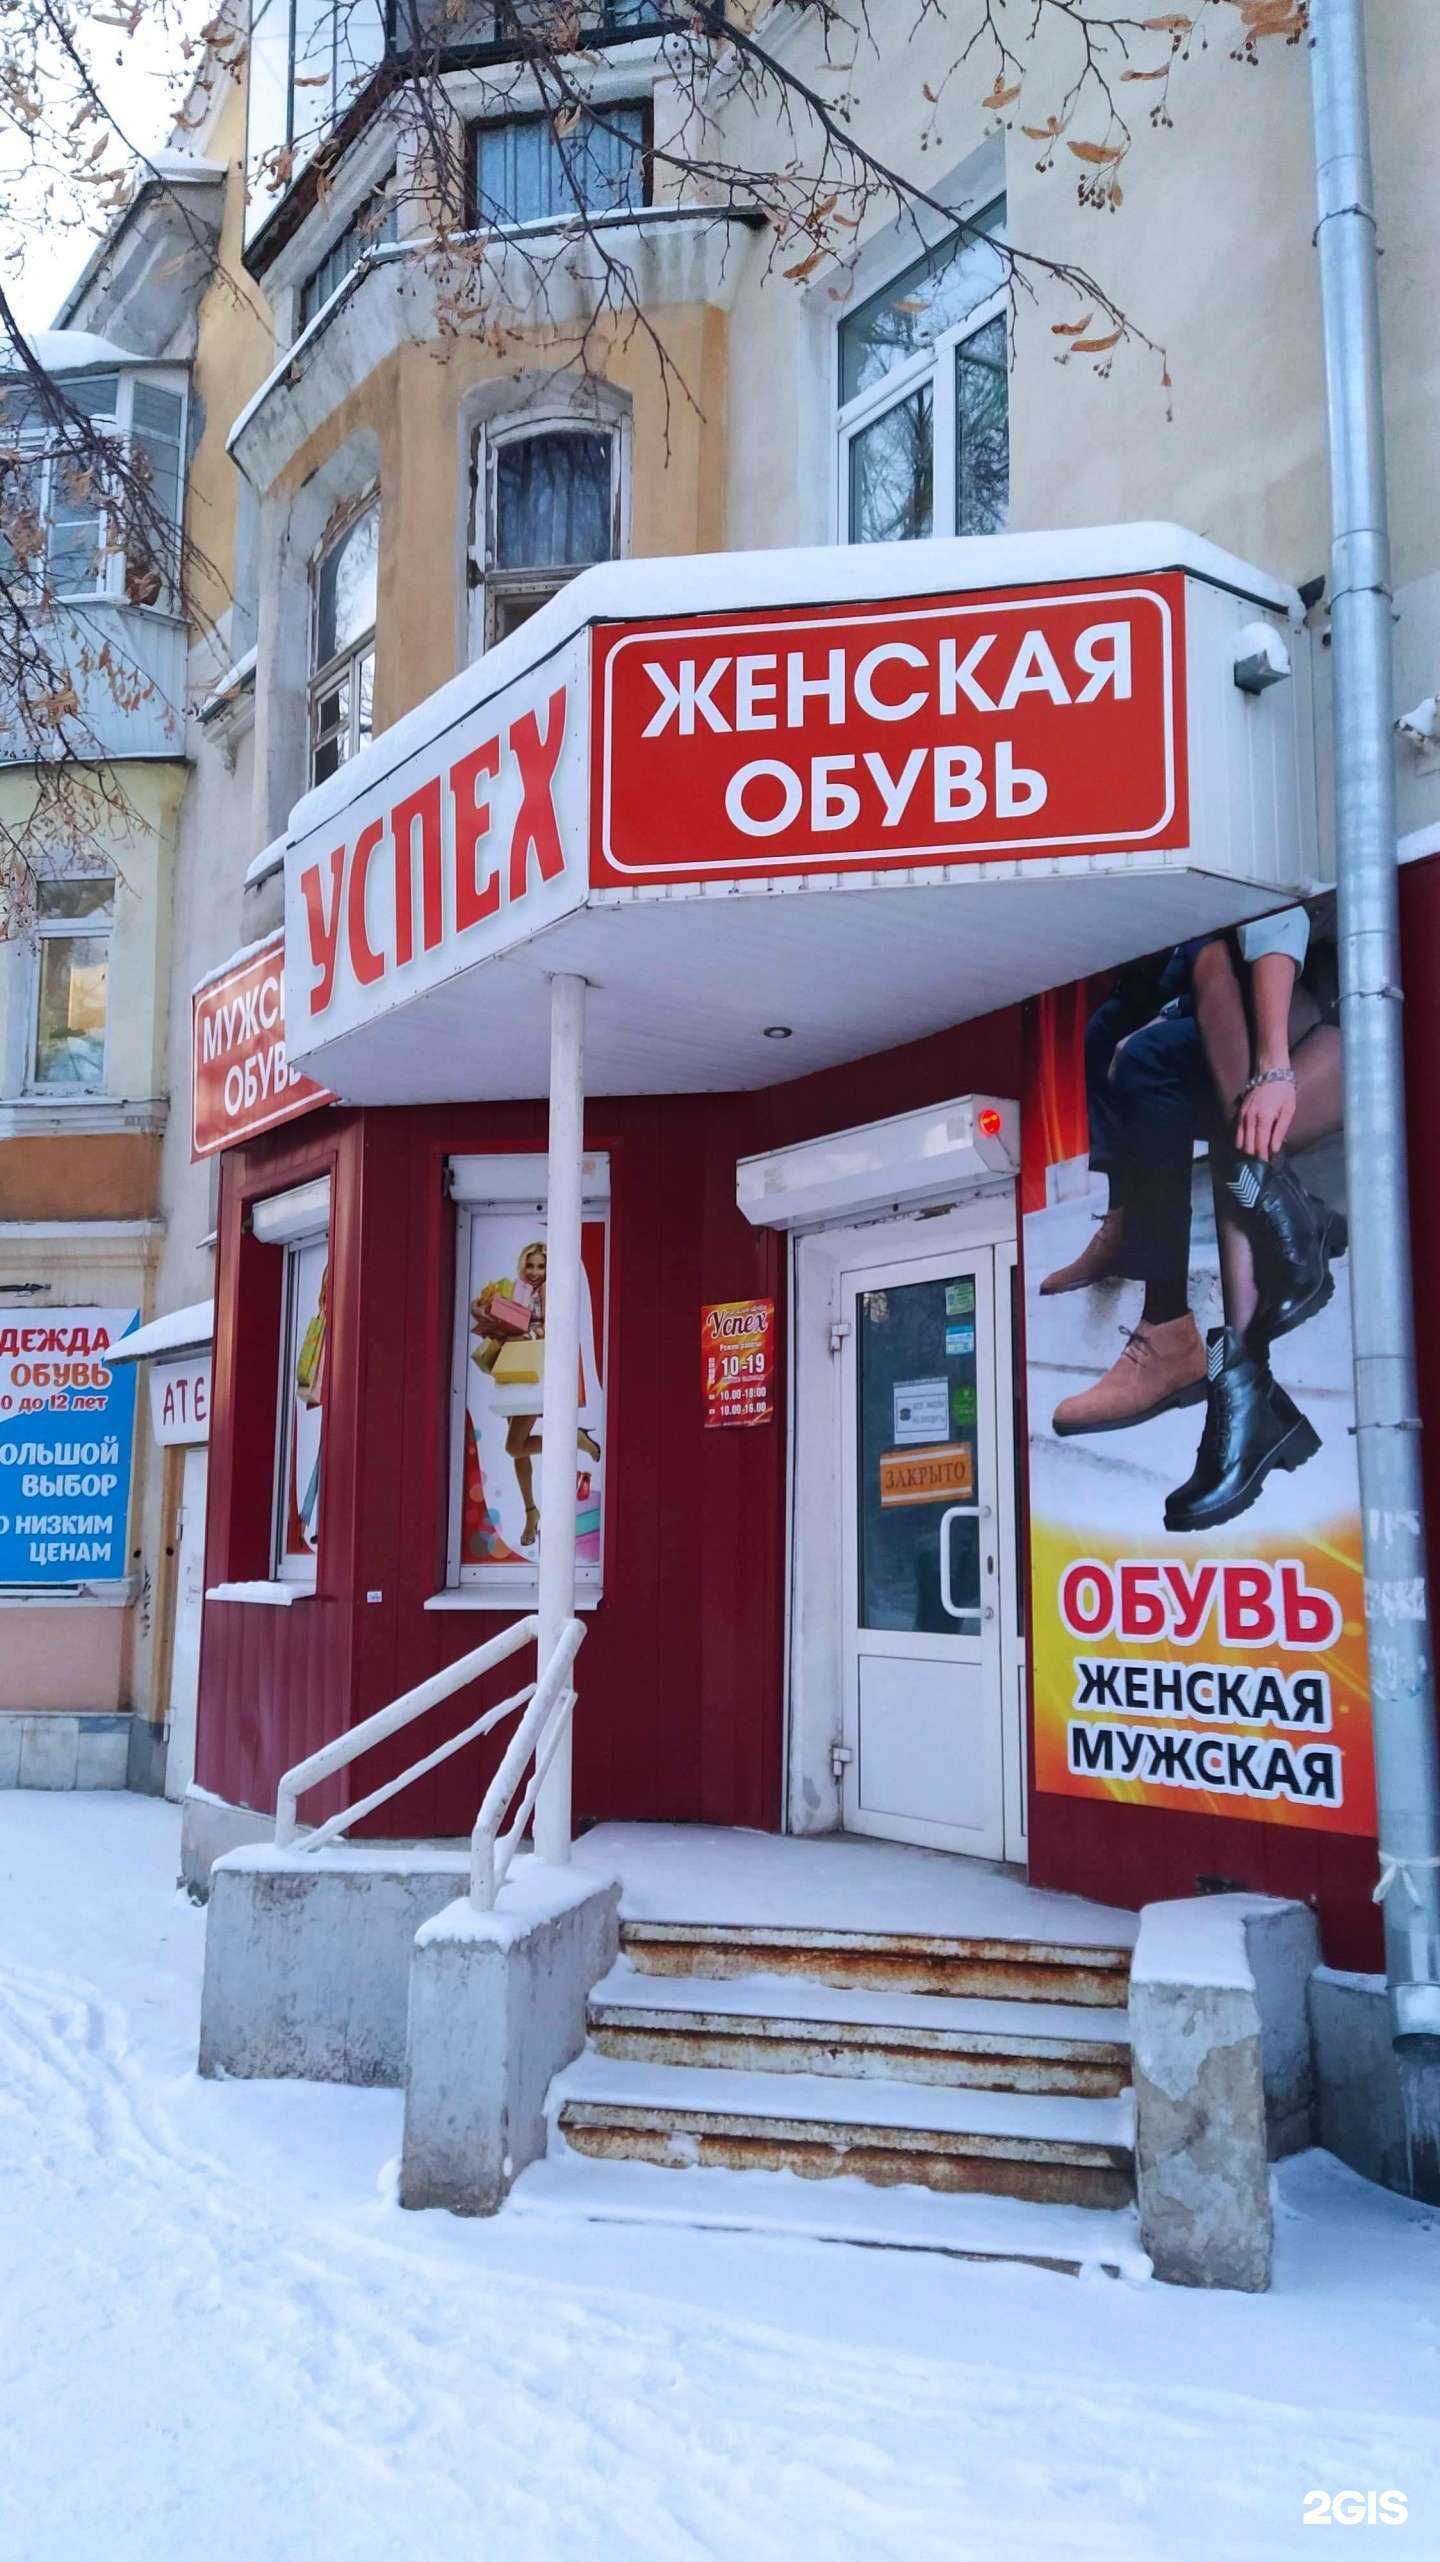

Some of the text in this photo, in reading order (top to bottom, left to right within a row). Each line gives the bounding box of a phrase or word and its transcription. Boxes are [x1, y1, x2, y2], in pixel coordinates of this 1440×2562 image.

[641, 621, 1132, 738] ЖЕНСКАЯ
[725, 740, 1048, 837] ОБУВЬ
[300, 684, 567, 1016] УСПЕХ
[203, 969, 285, 1064] МУЖС
[706, 1311, 768, 1339] Успех
[10, 1363, 111, 1388] ОБУВЬ
[721, 1353, 764, 1376] 10-19
[19, 1398, 43, 1411] до
[50, 1394, 68, 1409] 12
[73, 1397, 106, 1410] лет
[163, 1376, 206, 1426] АТЕ
[0, 1436, 119, 1465] ОЛЬШОЙ
[22, 1474, 118, 1497] ВЫБОР
[885, 1462, 966, 1489] ЗАКРЫТО
[15, 1515, 113, 1535] НИЗКИМ
[29, 1542, 111, 1566] ЦЕНАМ
[1062, 1564, 1335, 1643] ОБУВЬ
[1078, 1663, 1324, 1724] ЖЕНСКАЯ
[1072, 1727, 1337, 1799] МУЖСКАЯ
